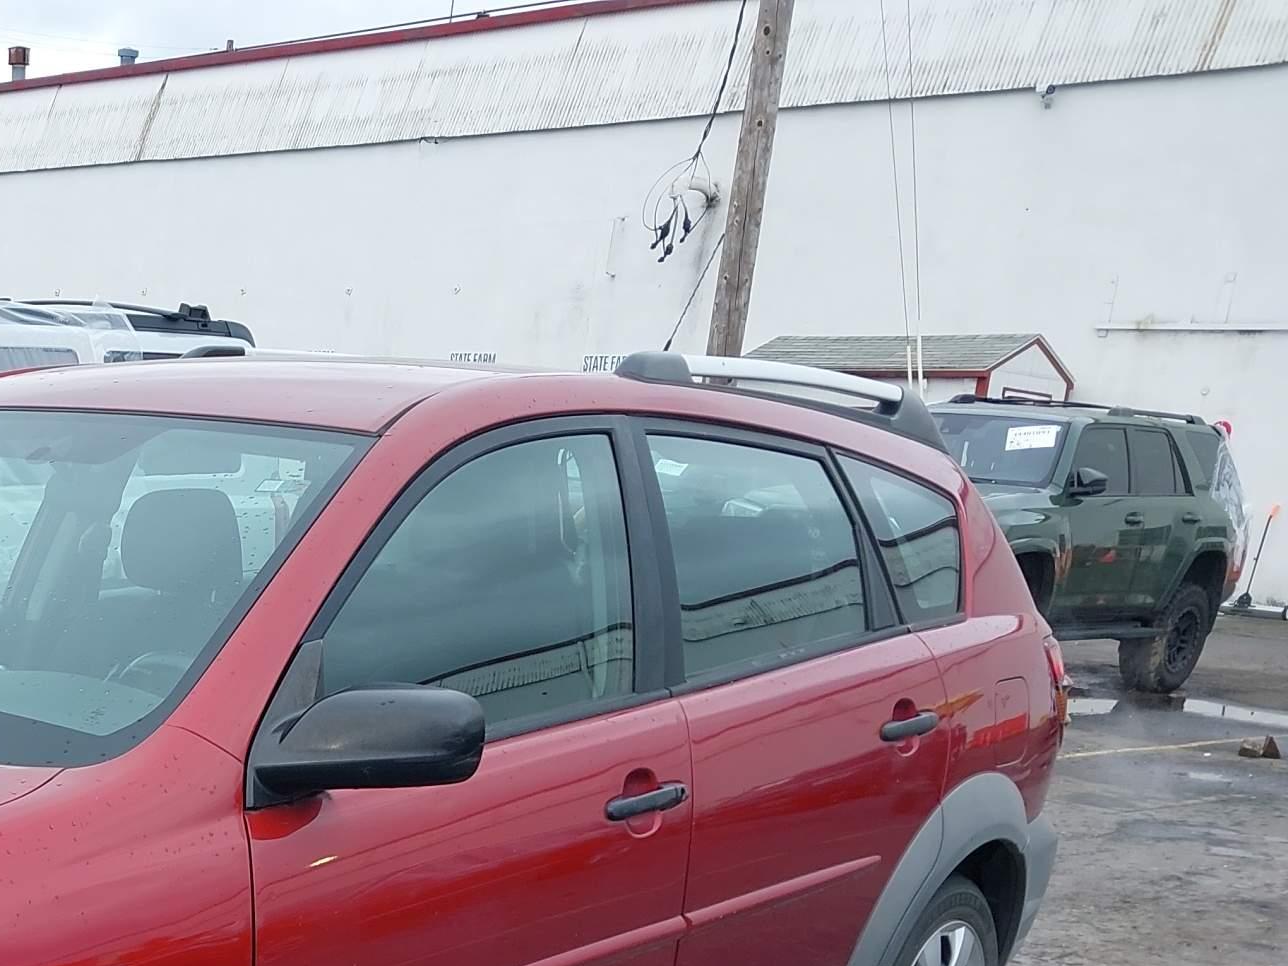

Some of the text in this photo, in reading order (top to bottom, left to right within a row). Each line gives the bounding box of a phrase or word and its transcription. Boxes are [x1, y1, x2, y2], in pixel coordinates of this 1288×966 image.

[450, 352, 497, 363] STATE FARM
[583, 355, 626, 372] STATE FA
